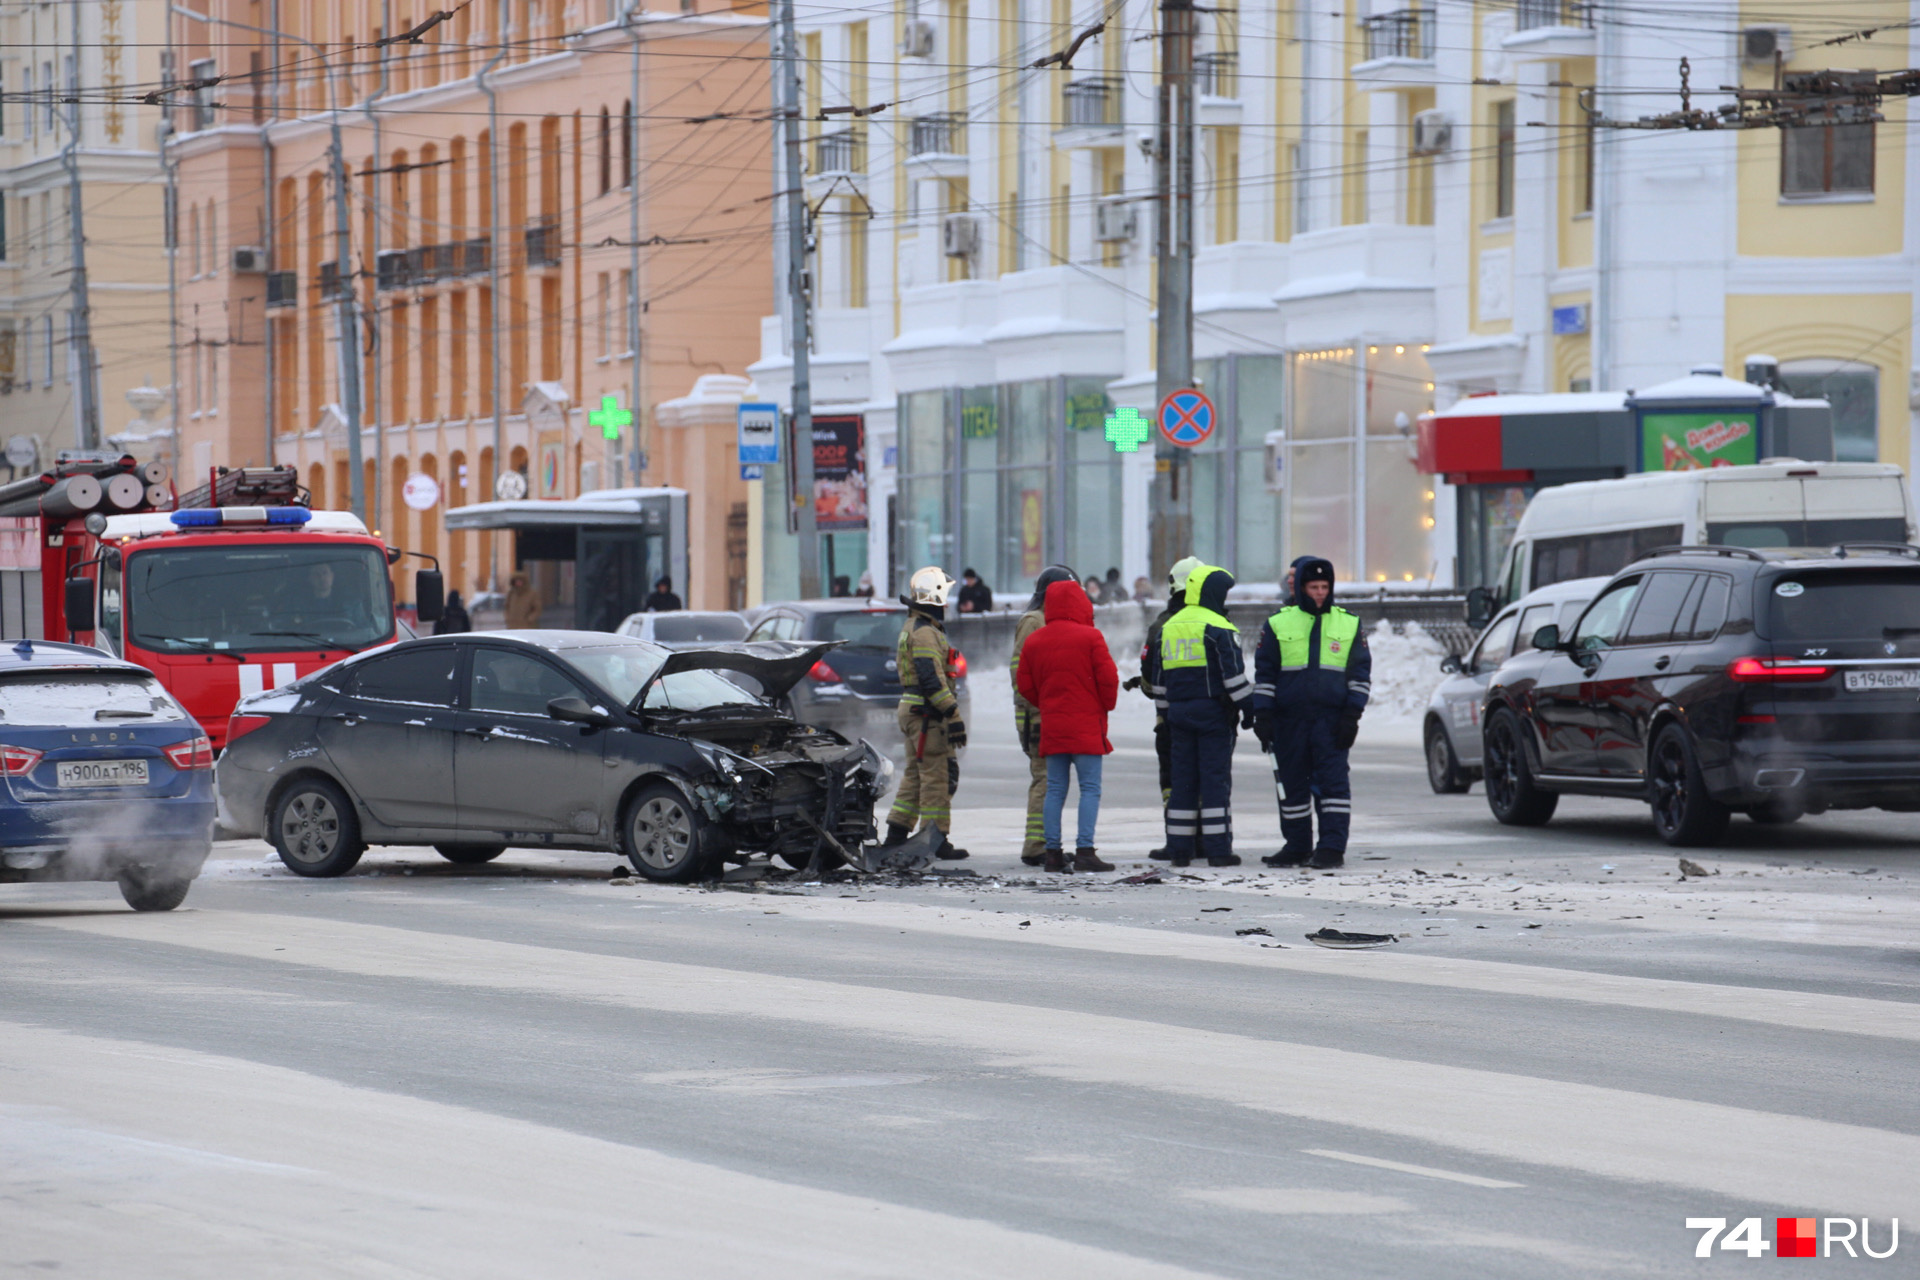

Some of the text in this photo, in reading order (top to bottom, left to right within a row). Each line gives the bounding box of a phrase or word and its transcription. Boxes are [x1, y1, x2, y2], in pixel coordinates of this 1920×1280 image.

[1163, 638, 1202, 660] ДПС
[1804, 648, 1828, 656] X7
[71, 732, 136, 743] LADA
